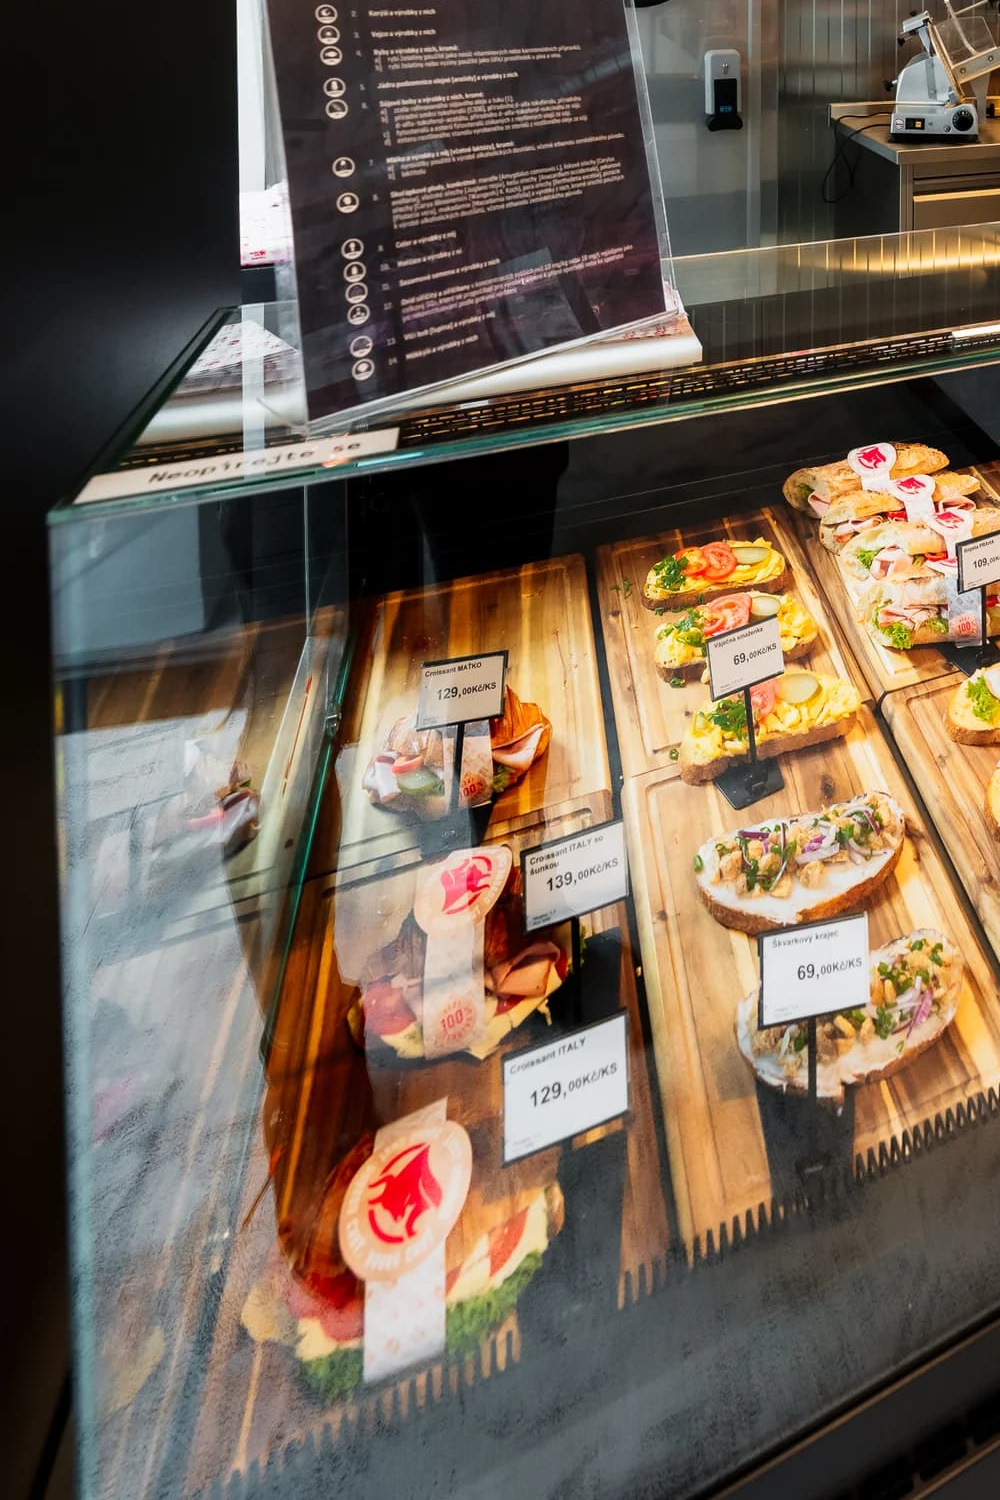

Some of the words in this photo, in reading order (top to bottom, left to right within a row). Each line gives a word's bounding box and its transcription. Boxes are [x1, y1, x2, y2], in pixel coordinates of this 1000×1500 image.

[546, 857, 619, 892] 139,00Kč/KS
[797, 957, 862, 980] 69,00Kč/KS
[509, 1051, 557, 1075] Croissant
[557, 1037, 586, 1056] ITALY
[530, 1062, 618, 1108] 129,00Kč/KS
